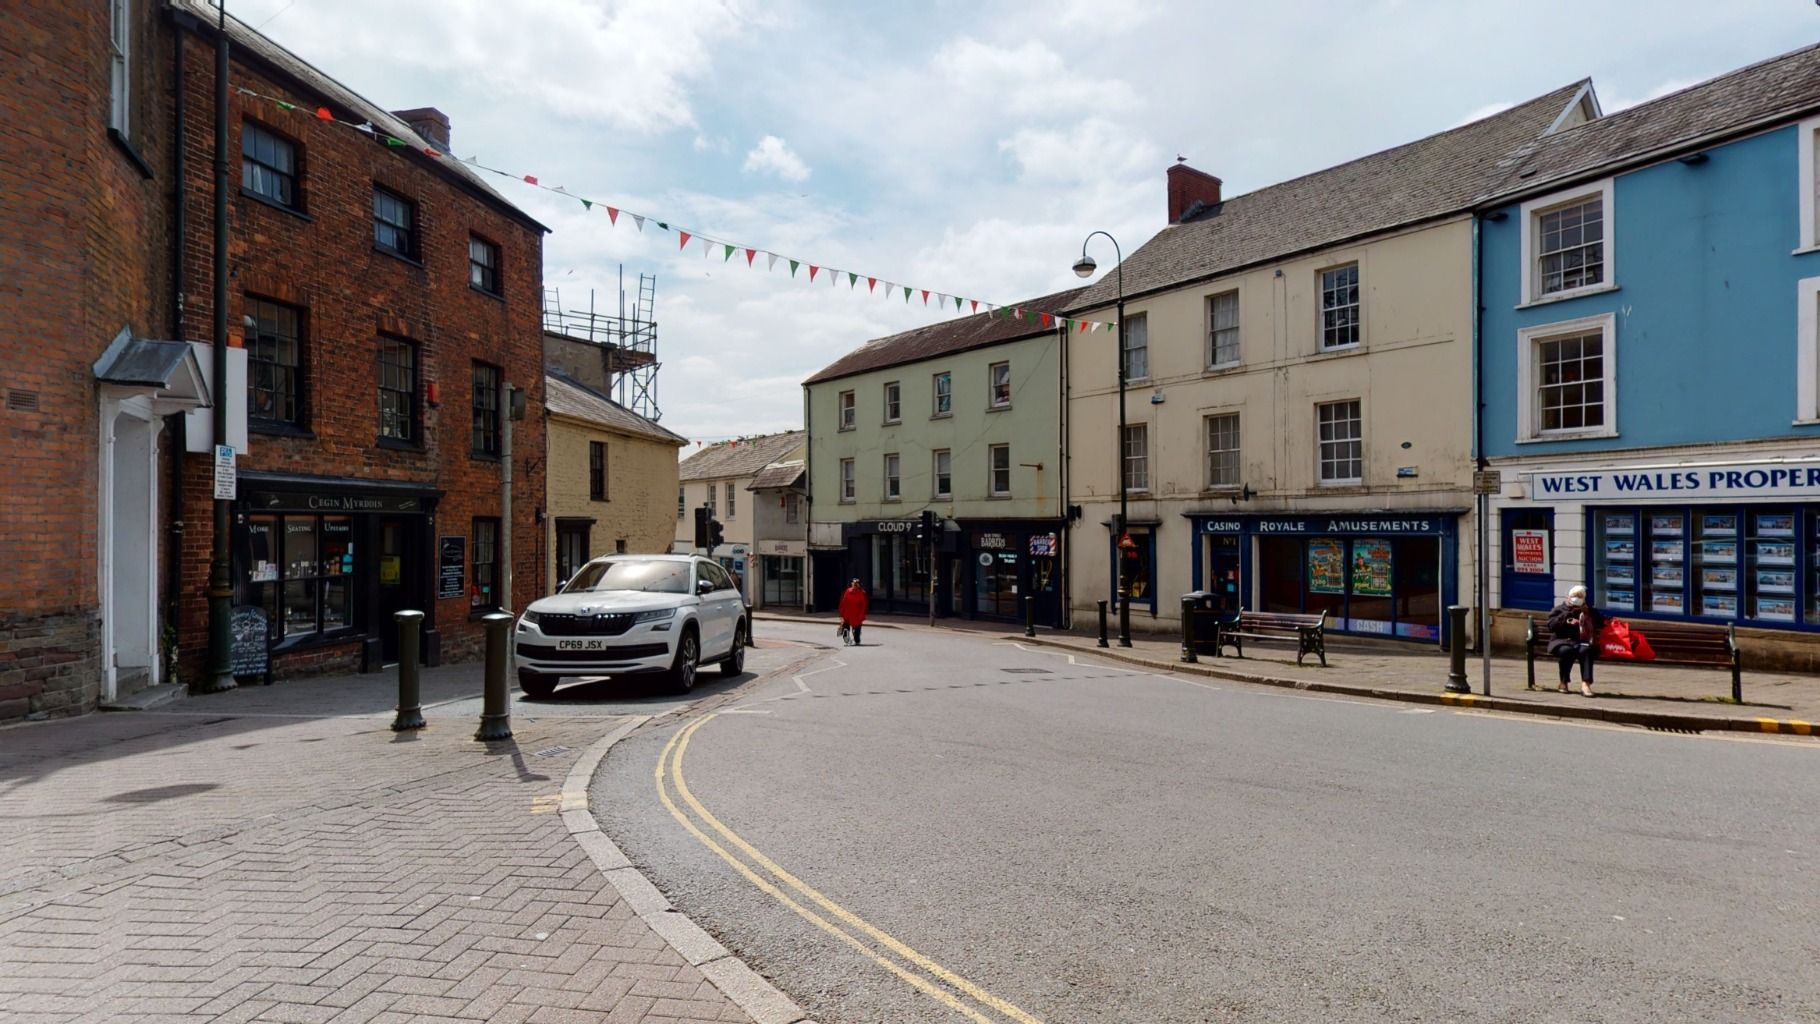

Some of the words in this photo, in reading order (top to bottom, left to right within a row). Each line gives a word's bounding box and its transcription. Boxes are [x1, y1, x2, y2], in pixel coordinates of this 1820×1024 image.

[1542, 477, 1602, 493] WEST
[1613, 472, 1699, 491] WALES
[308, 495, 340, 509] CEGIN
[342, 497, 383, 509] MYRDDIN
[878, 522, 903, 532] CLOUD
[905, 522, 912, 532] 9
[1207, 521, 1241, 531] CASINO
[1259, 521, 1305, 532] ROYALE
[1328, 520, 1430, 532] AMUSEMENTS
[1356, 620, 1384, 633] CASH
[559, 640, 583, 649] CP69
[585, 640, 602, 649] JSX
